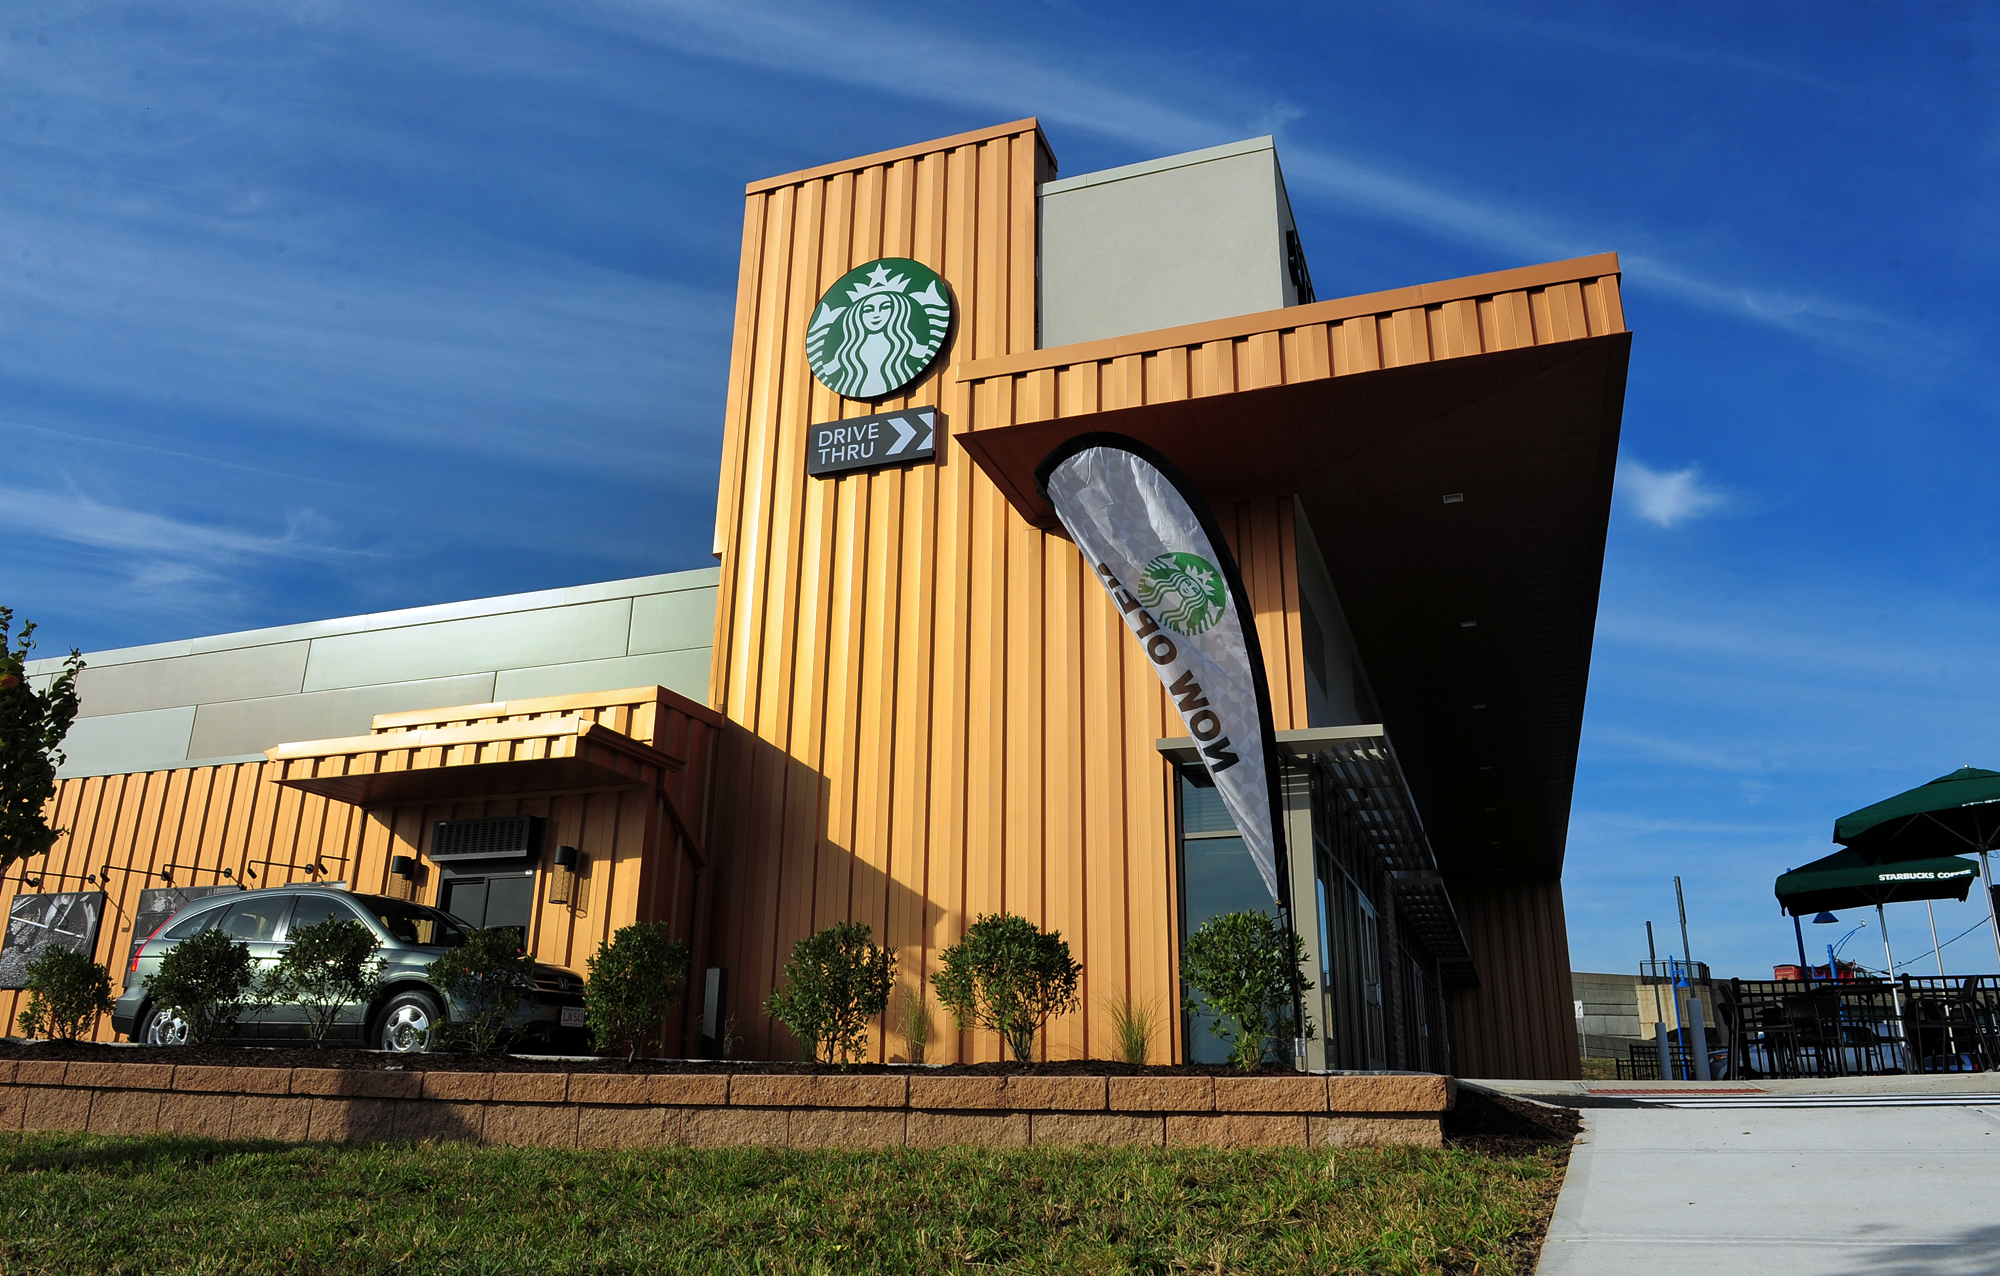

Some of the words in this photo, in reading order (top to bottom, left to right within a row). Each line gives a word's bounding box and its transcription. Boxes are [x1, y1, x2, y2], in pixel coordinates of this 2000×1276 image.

[818, 422, 880, 447] DRIVE
[818, 441, 874, 465] THRU
[1879, 872, 1935, 881] STARBUCKS
